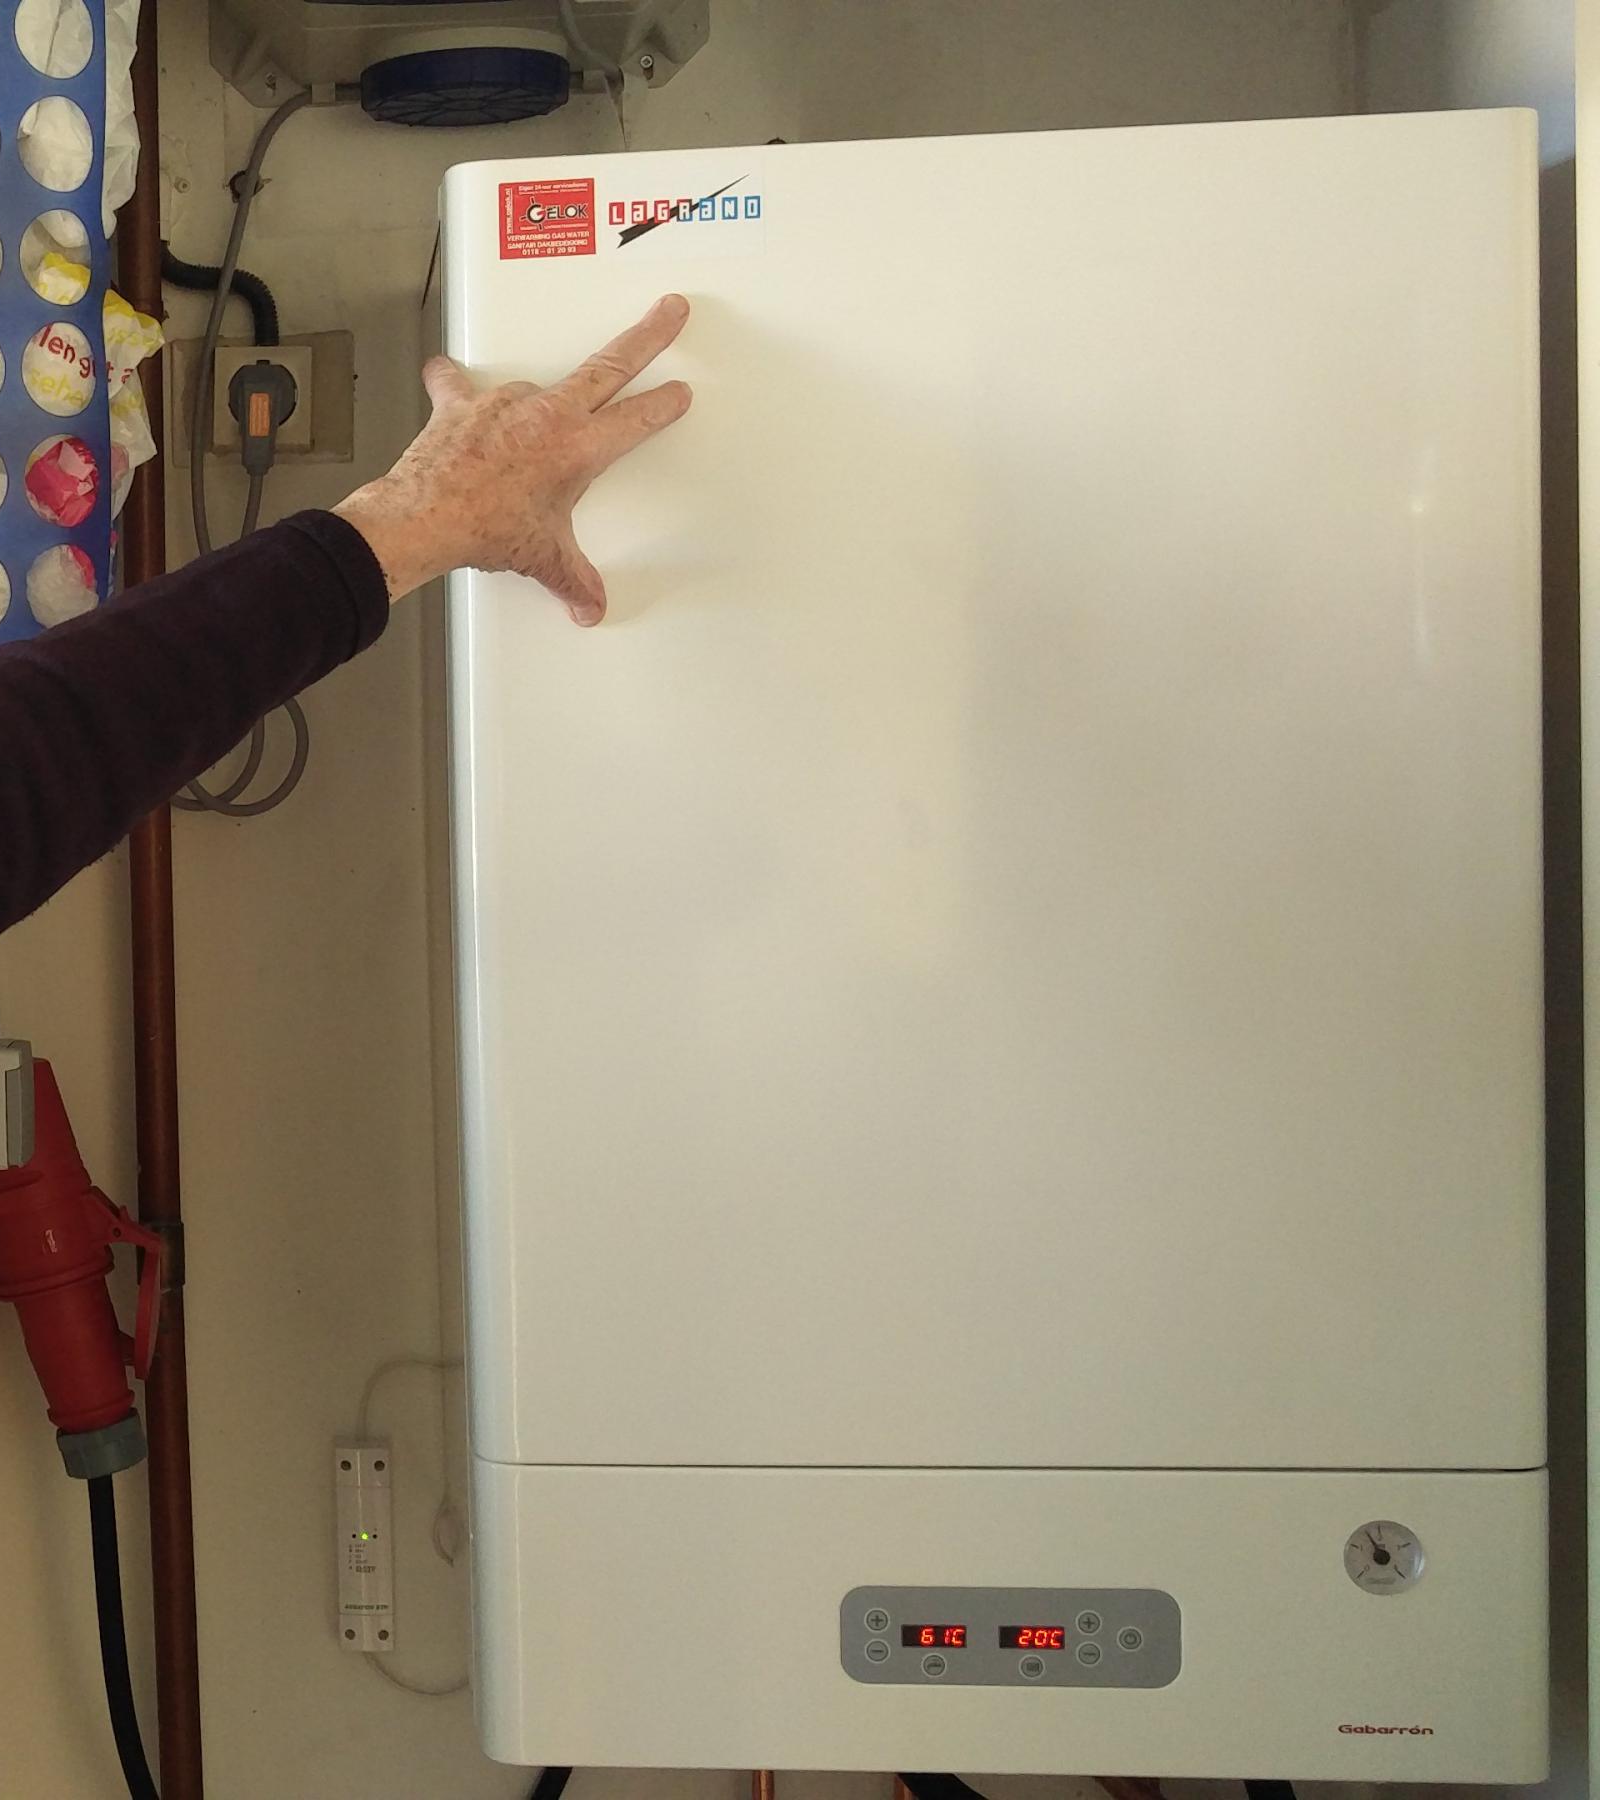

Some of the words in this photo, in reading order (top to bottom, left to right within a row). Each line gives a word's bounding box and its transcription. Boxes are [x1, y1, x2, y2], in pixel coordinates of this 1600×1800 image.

[525, 202, 588, 224] GELOK
[551, 231, 566, 240] GAS
[566, 230, 590, 239] WATER
[1338, 1723, 1434, 1736] Gabarrón
